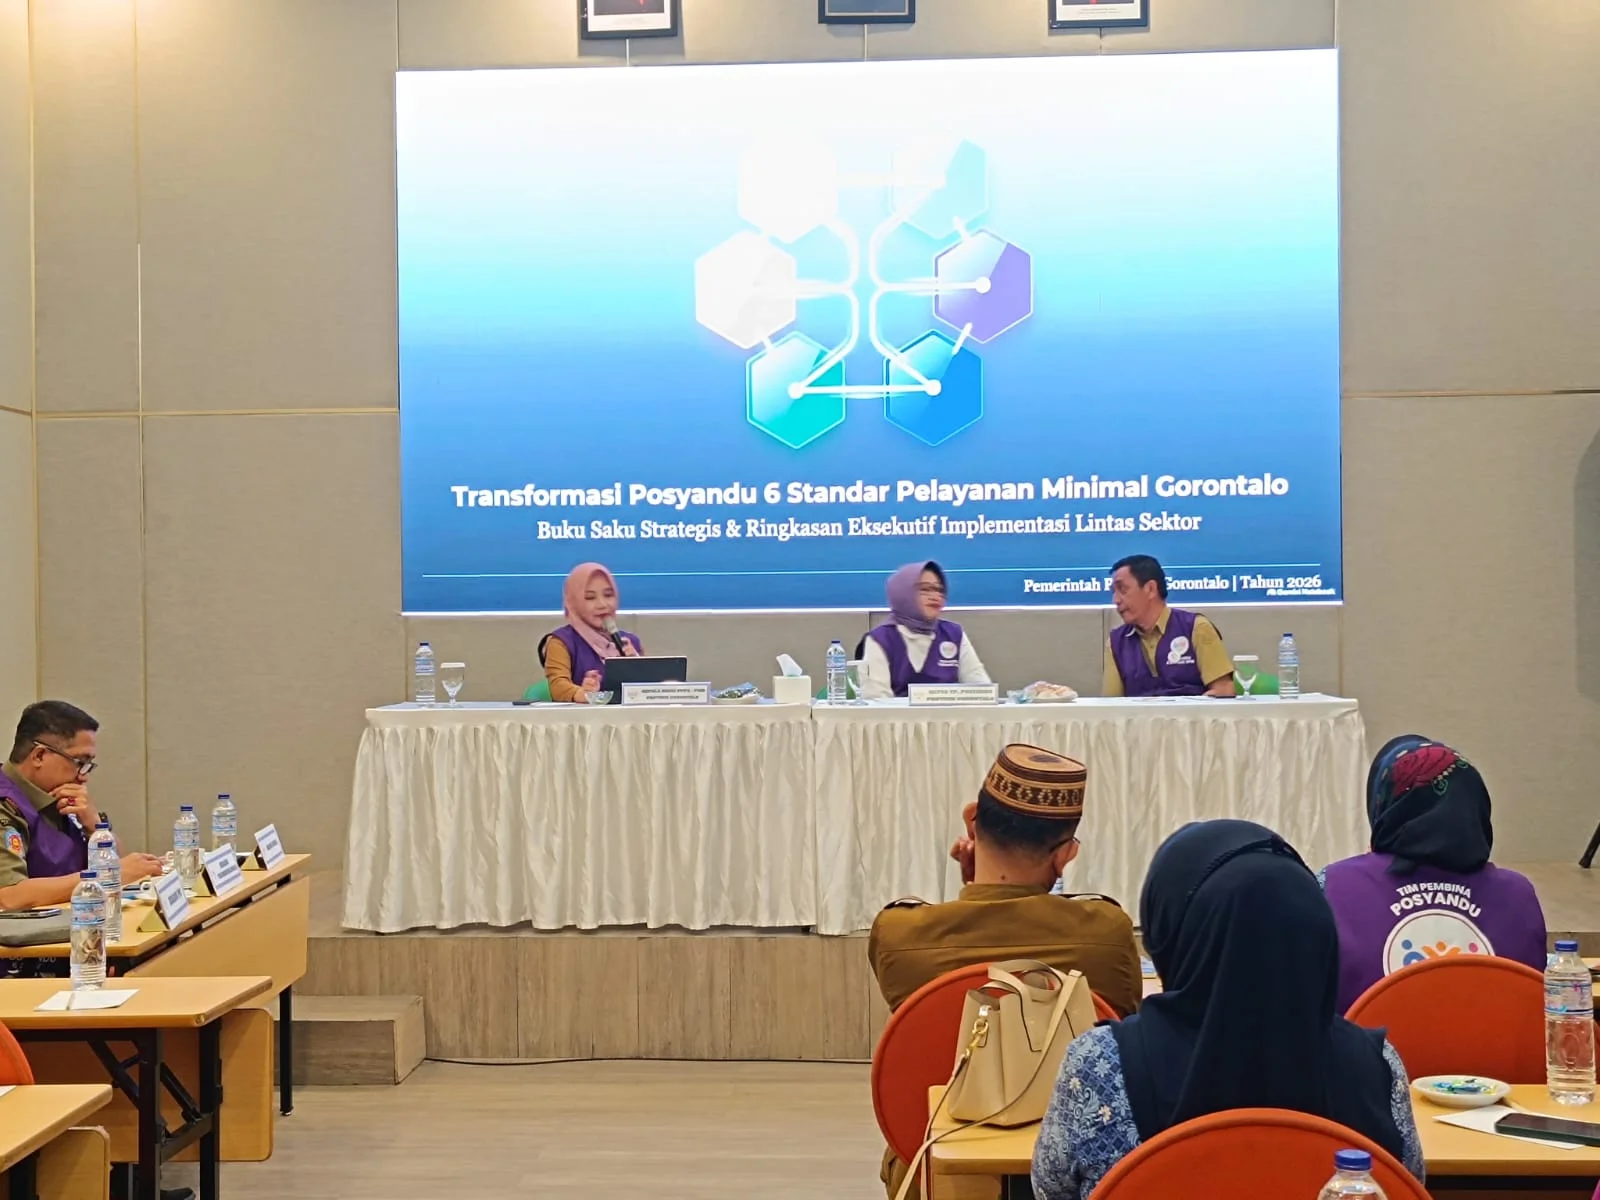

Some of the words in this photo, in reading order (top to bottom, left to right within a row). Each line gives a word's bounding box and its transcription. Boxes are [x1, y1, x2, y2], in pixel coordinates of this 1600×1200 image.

[451, 483, 621, 507] Transformasi
[629, 482, 756, 510] Posyandu
[764, 482, 780, 504] 6
[787, 480, 889, 504] Standar
[897, 479, 1034, 507] Pelayanan
[1042, 475, 1148, 499] Minimal
[1155, 473, 1289, 498] Gorontalo
[537, 520, 587, 540] Buku
[591, 520, 636, 539] Saku
[641, 519, 722, 543] Strategis
[726, 520, 741, 538] &
[746, 518, 842, 542] Ringkasan
[848, 516, 937, 537] Eksekutif
[941, 514, 1070, 540] Implementasi
[1076, 513, 1134, 533] Lintas
[1139, 512, 1202, 532] Sektor
[1023, 578, 1100, 593] Pemerintah
[1240, 574, 1285, 590] Tahun
[1288, 575, 1322, 588] 2026
[1396, 883, 1418, 896] TIM
[1420, 882, 1471, 898] PEMBINA
[1390, 892, 1482, 918] POSYANDU
